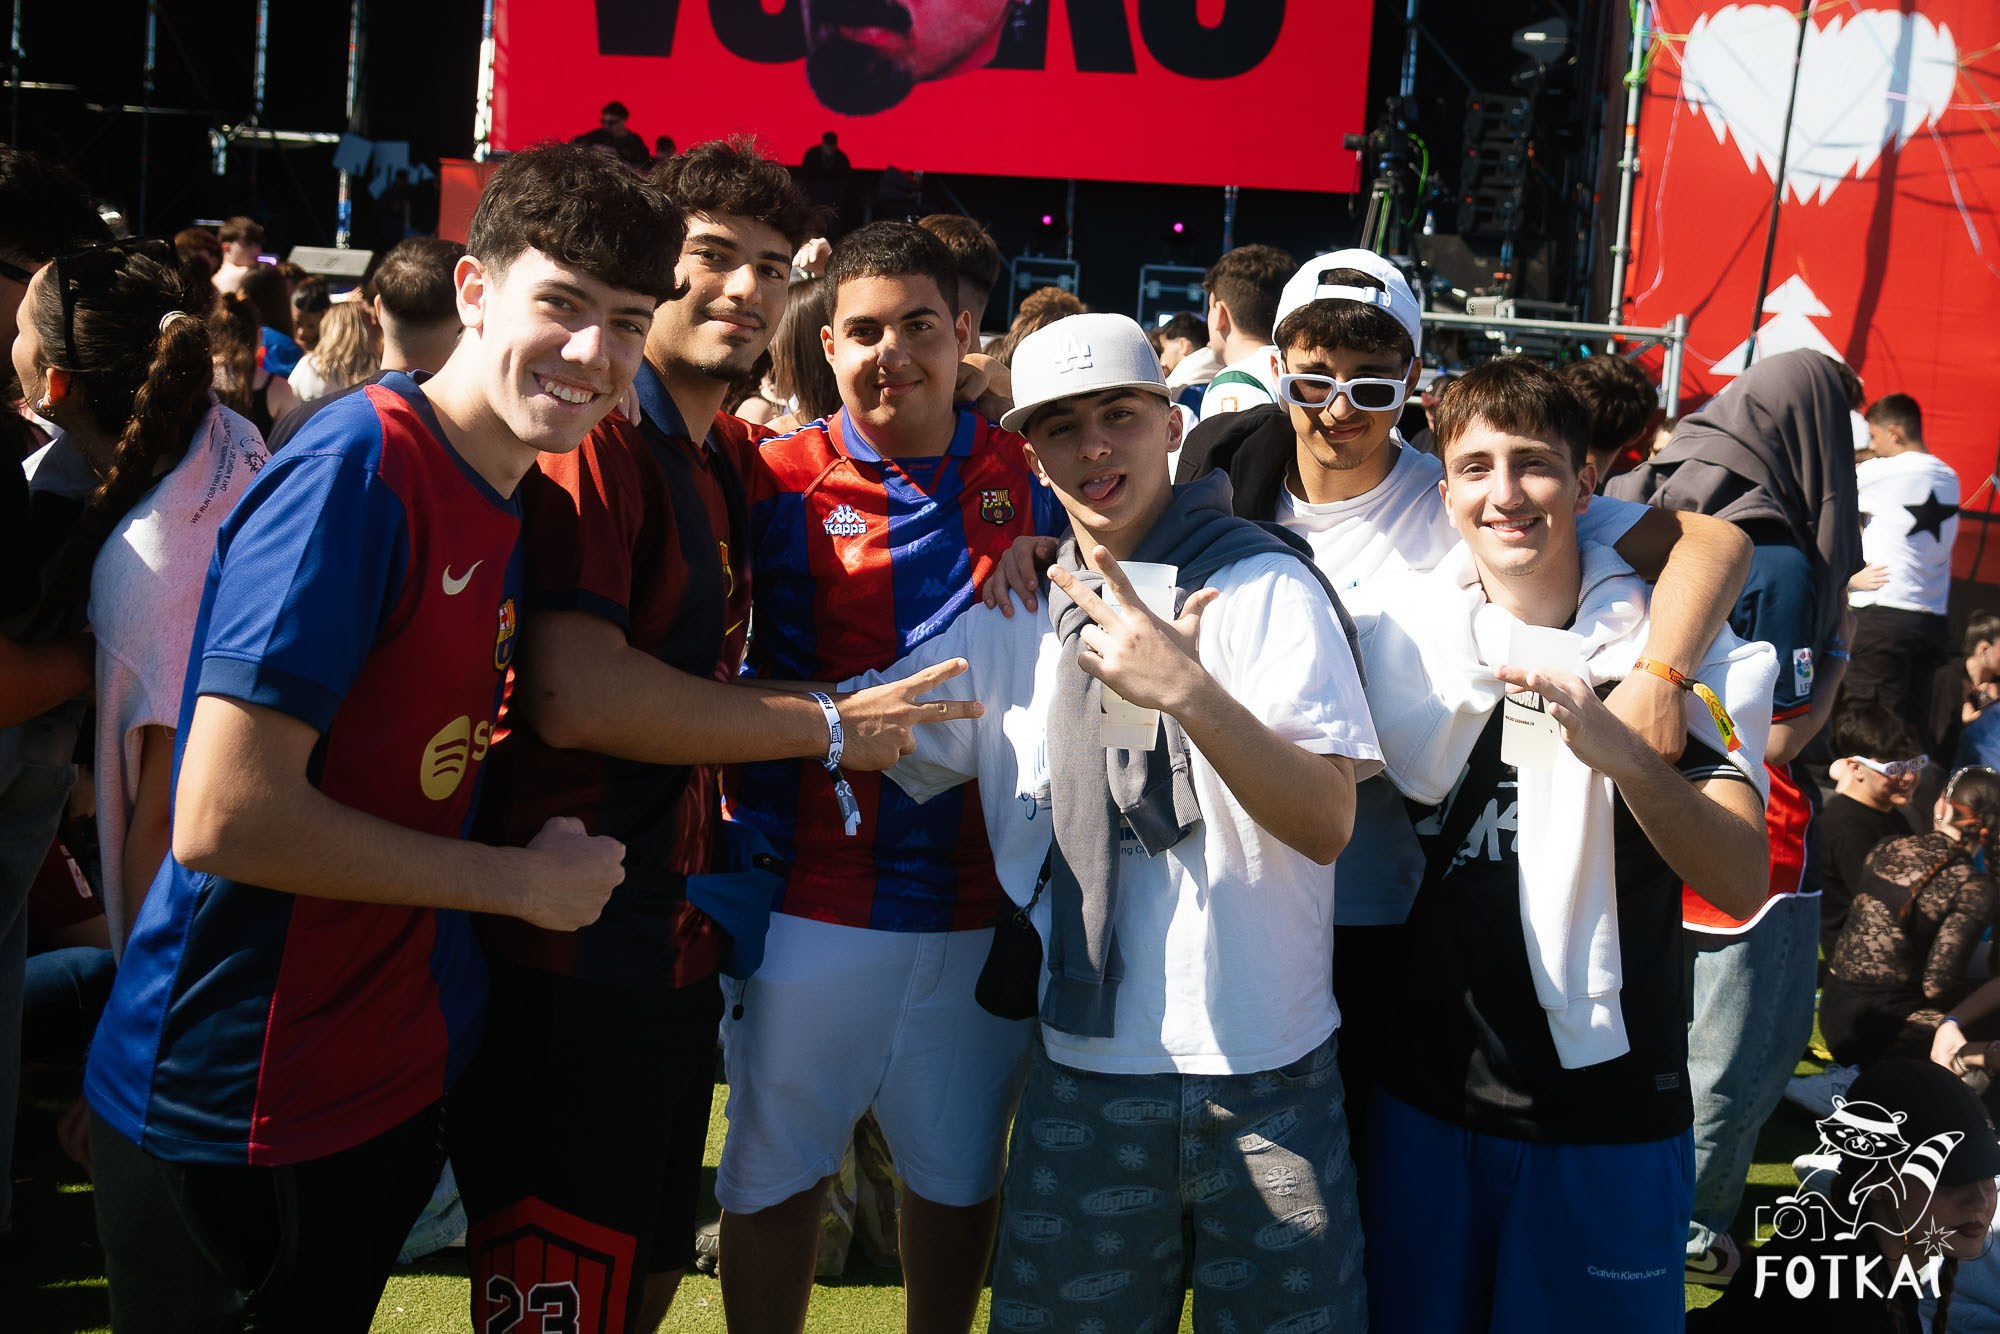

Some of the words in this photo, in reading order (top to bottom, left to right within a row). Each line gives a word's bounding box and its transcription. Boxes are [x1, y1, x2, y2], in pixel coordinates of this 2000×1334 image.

[190, 511, 202, 524] WE
[199, 498, 212, 513] RUN
[207, 485, 217, 499] OUR
[1092, 1189, 1155, 1213] digital
[1587, 1265, 1620, 1280] Calvin
[1620, 1269, 1643, 1280] Klein
[486, 1274, 580, 1334] 23
